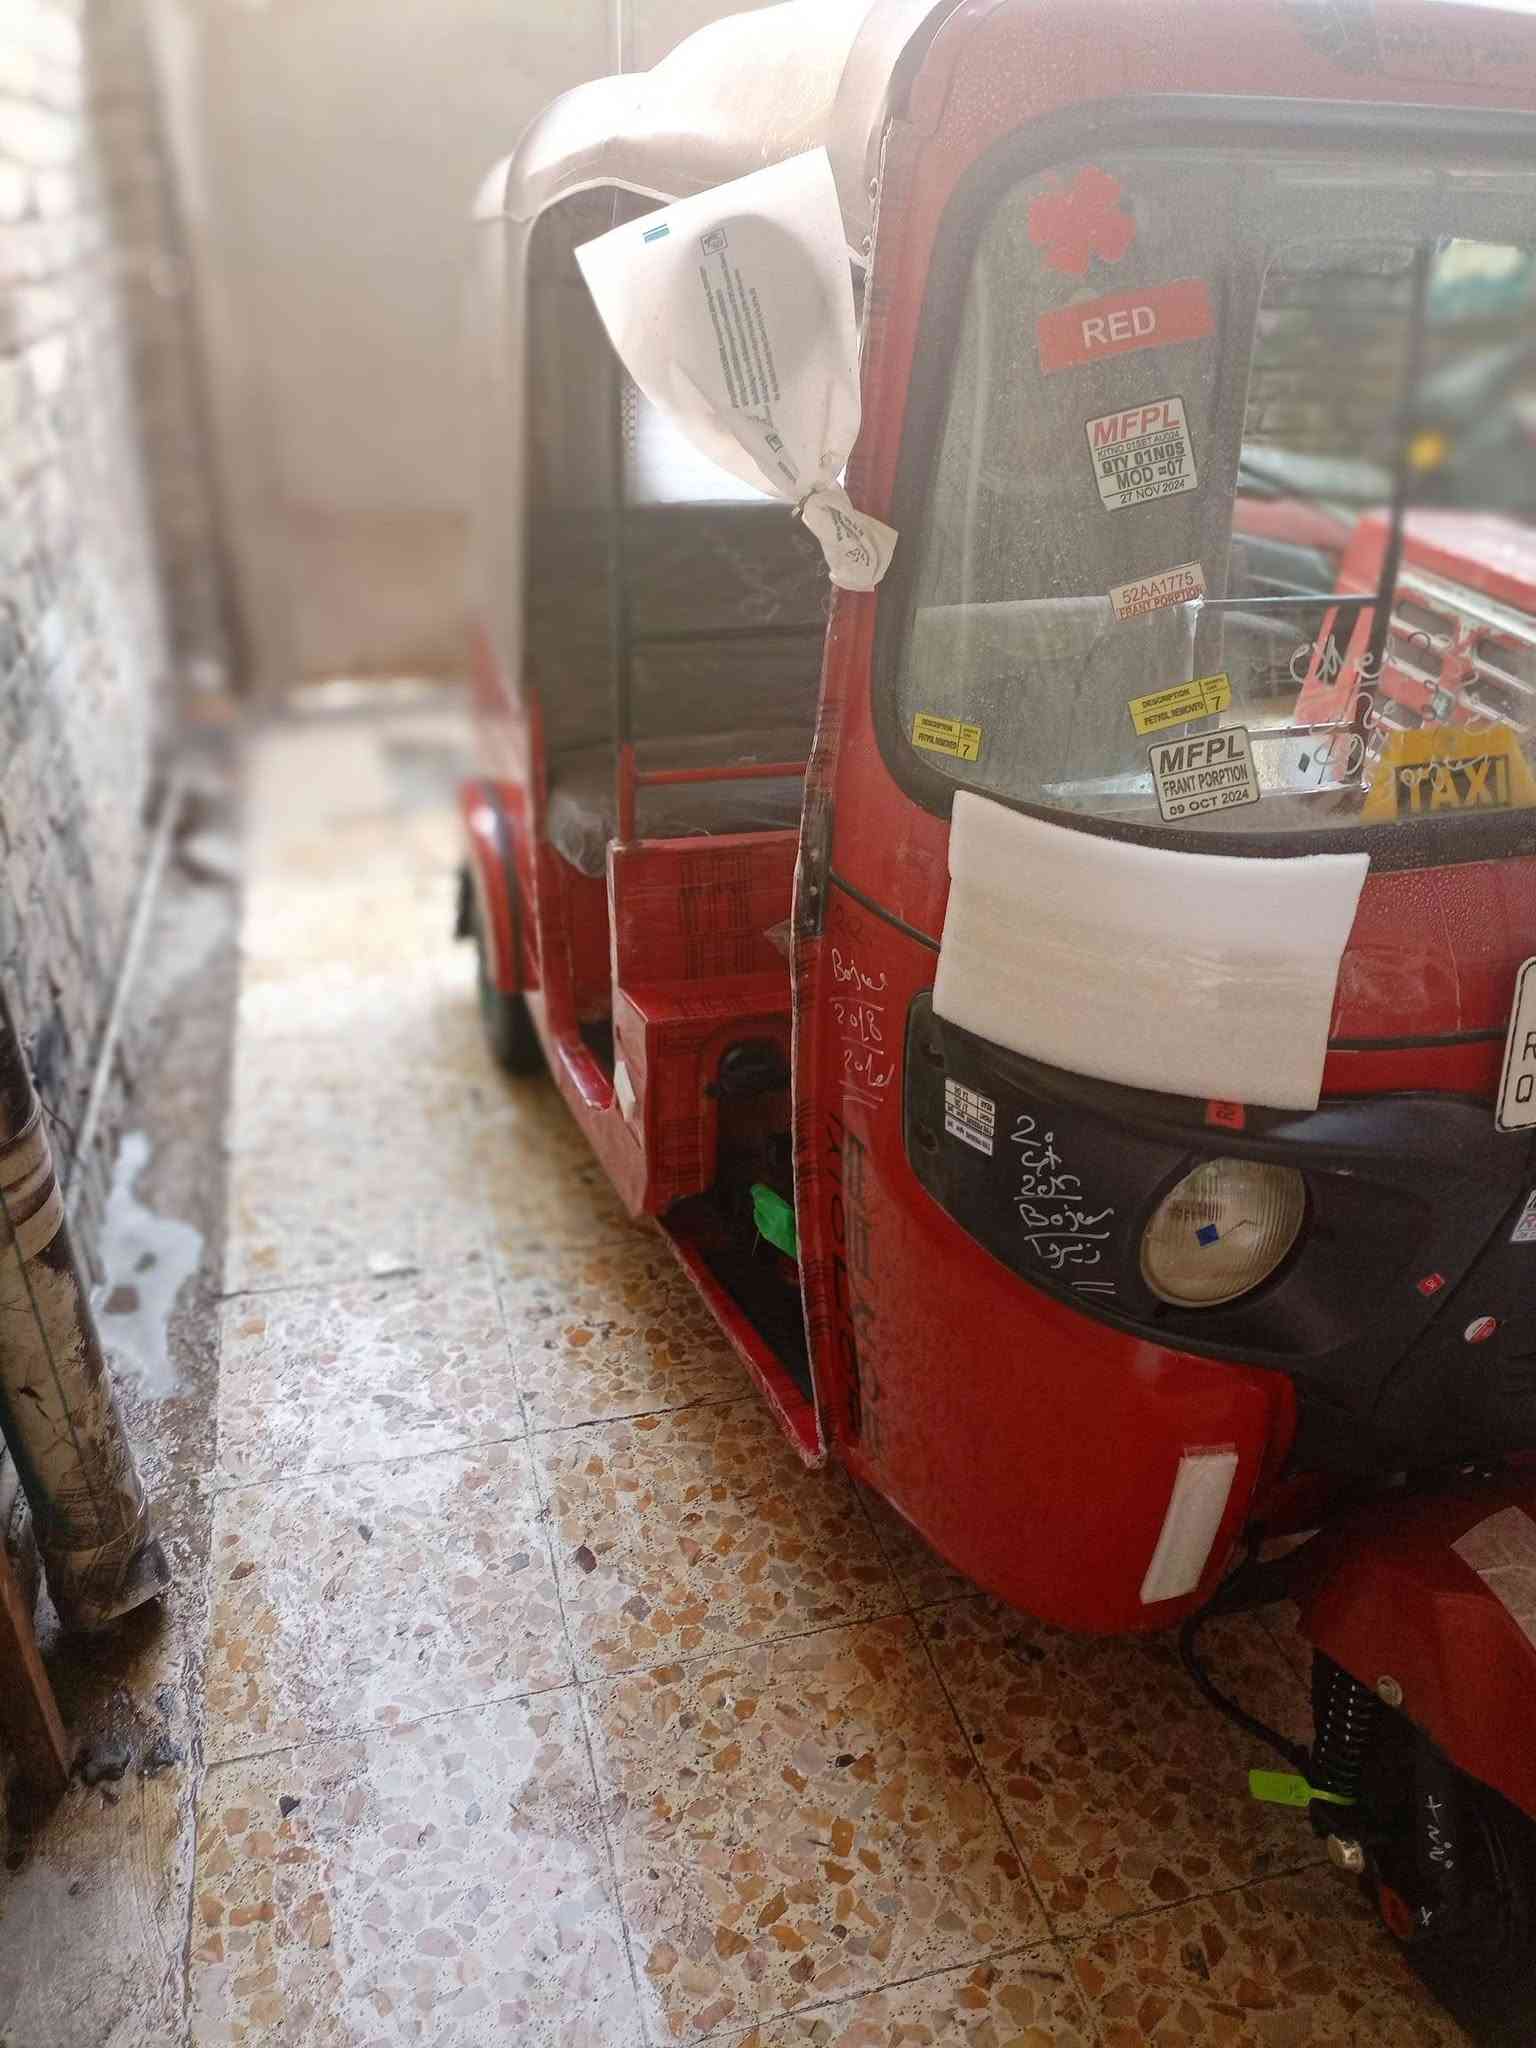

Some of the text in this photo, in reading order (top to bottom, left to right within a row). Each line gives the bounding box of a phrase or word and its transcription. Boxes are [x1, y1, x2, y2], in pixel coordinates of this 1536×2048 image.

[1081, 305, 1156, 349] RED
[1093, 403, 1182, 449] MFPL
[1102, 454, 1129, 475] QTY
[1116, 466, 1154, 490] MOD
[1120, 478, 1185, 505] 27 NOV 2024
[1210, 695, 1221, 712] 7
[963, 743, 971, 758] 7
[1159, 735, 1245, 775] MFPL
[1162, 763, 1248, 799] FRANT PORPTION
[1400, 758, 1507, 811] TAXI
[1169, 788, 1250, 816] 09 OCT 2024
